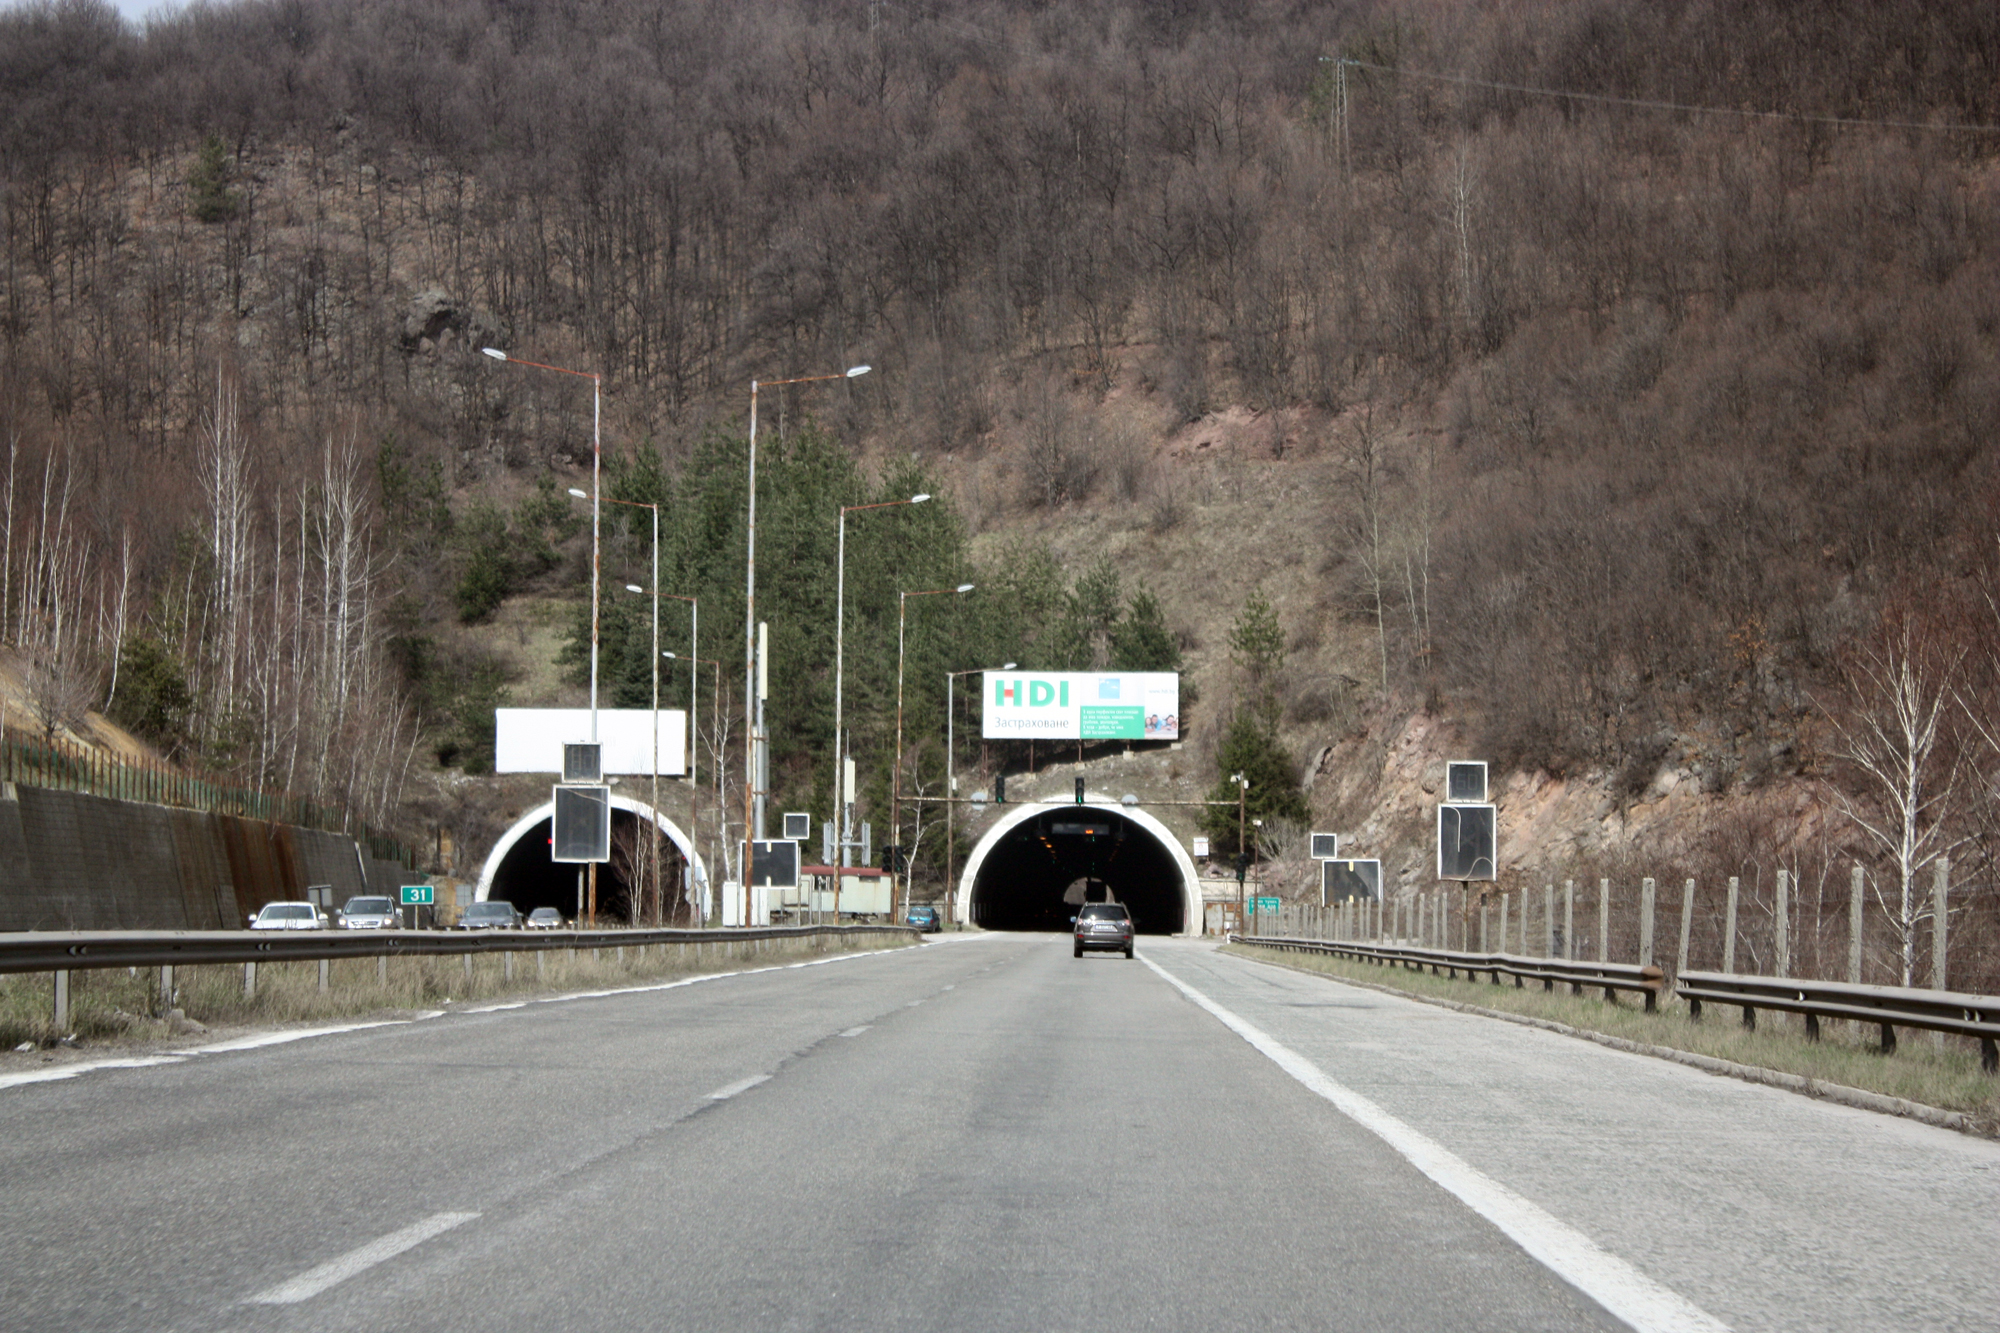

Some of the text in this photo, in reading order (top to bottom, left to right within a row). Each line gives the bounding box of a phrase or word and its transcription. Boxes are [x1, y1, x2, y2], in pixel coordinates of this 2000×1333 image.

[996, 680, 1069, 707] HDI
[995, 717, 1069, 730] Застраховане
[411, 889, 425, 901] 31
